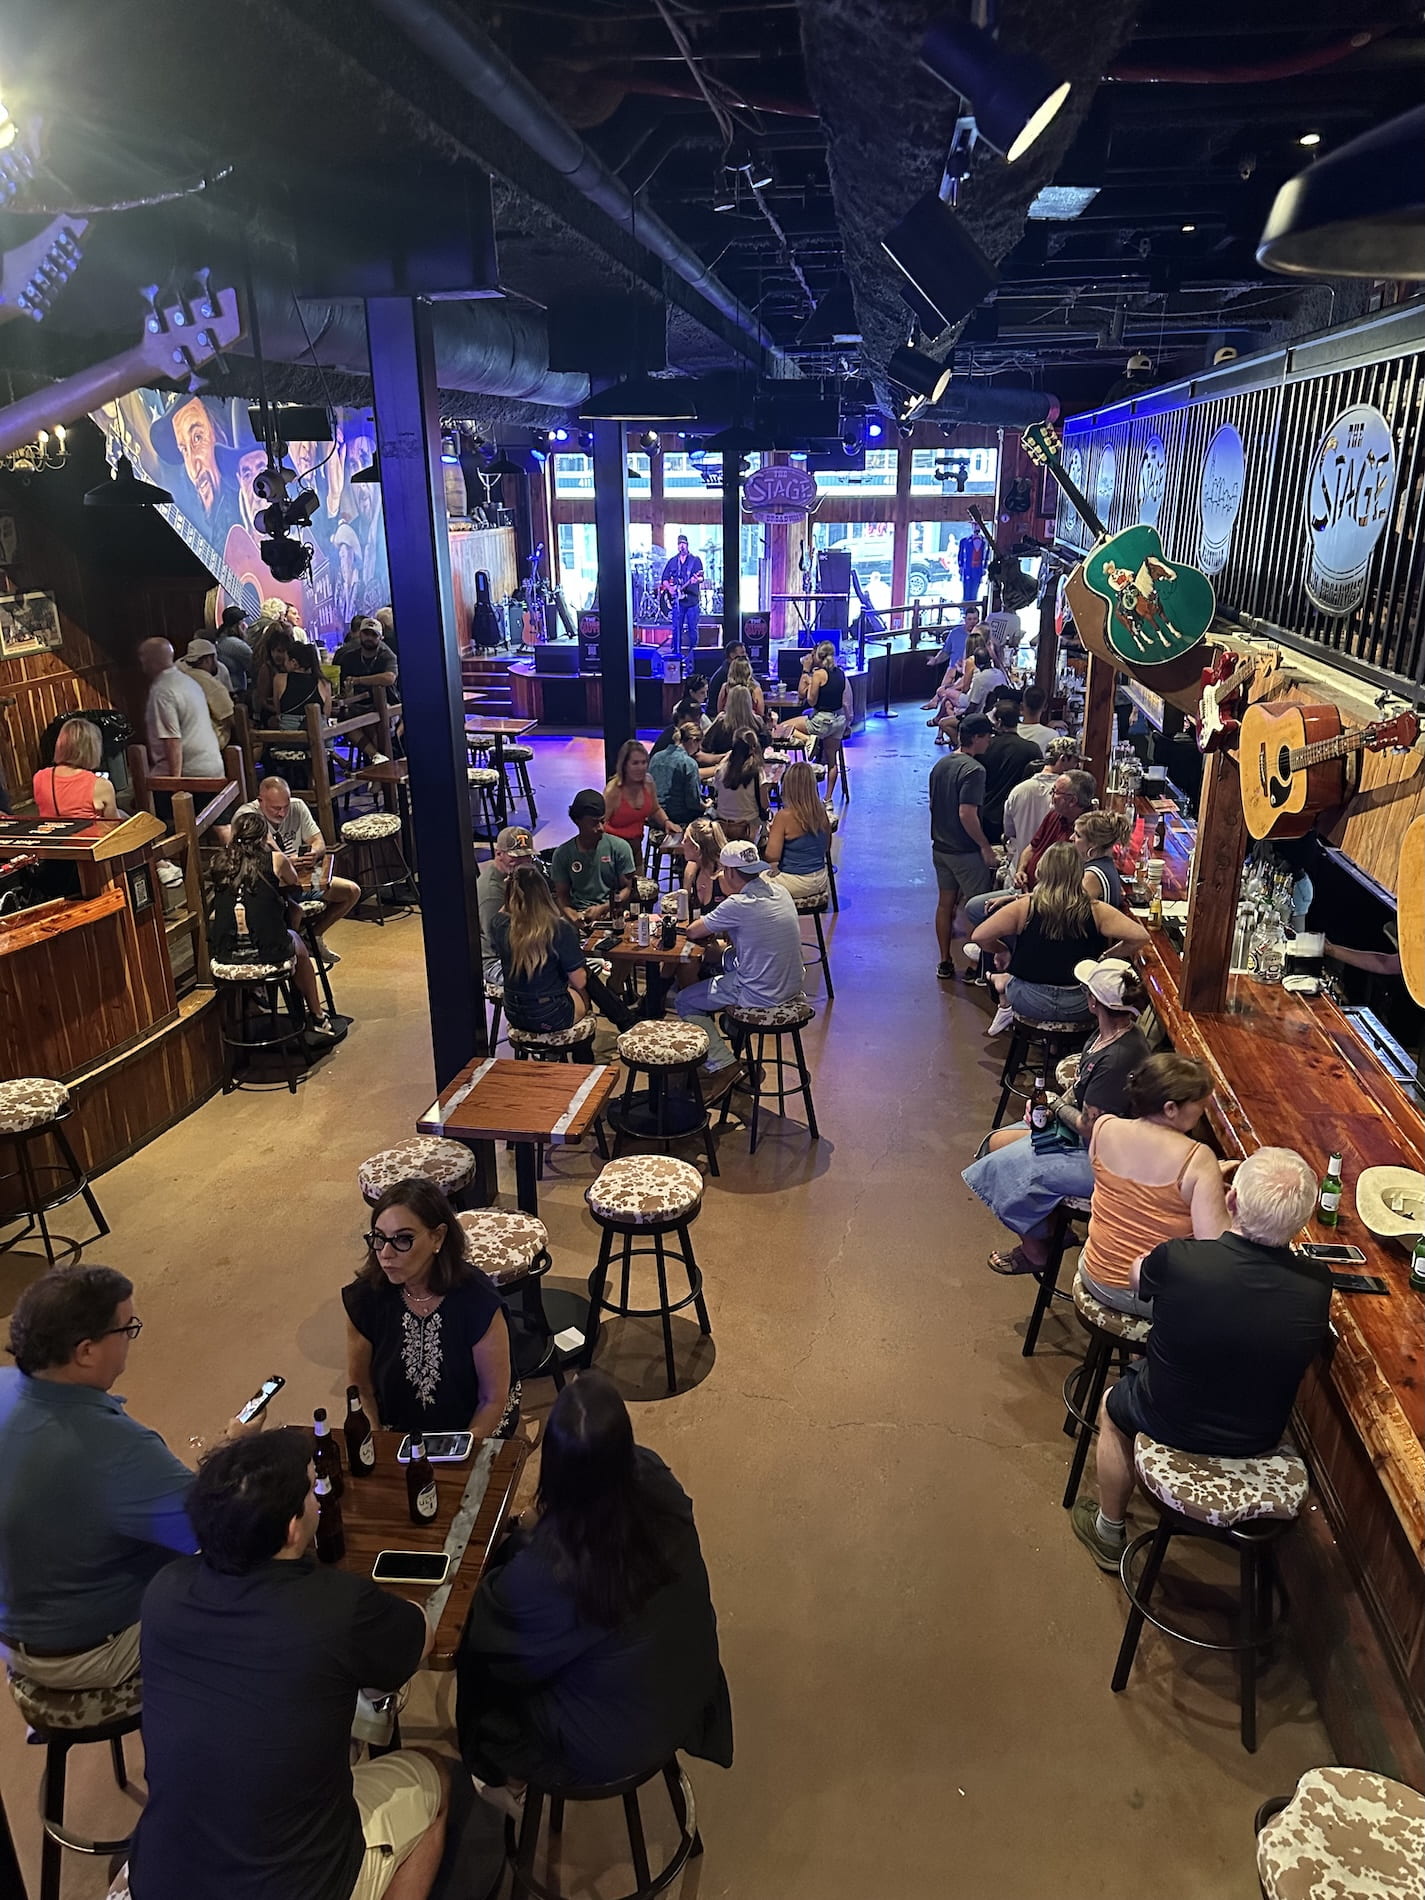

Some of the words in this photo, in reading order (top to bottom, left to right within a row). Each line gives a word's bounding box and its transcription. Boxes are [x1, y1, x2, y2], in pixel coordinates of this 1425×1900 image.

[1347, 423, 1364, 448] THE
[746, 473, 812, 502] STAGE
[1311, 436, 1389, 532] STAGE
[516, 834, 529, 847] T
